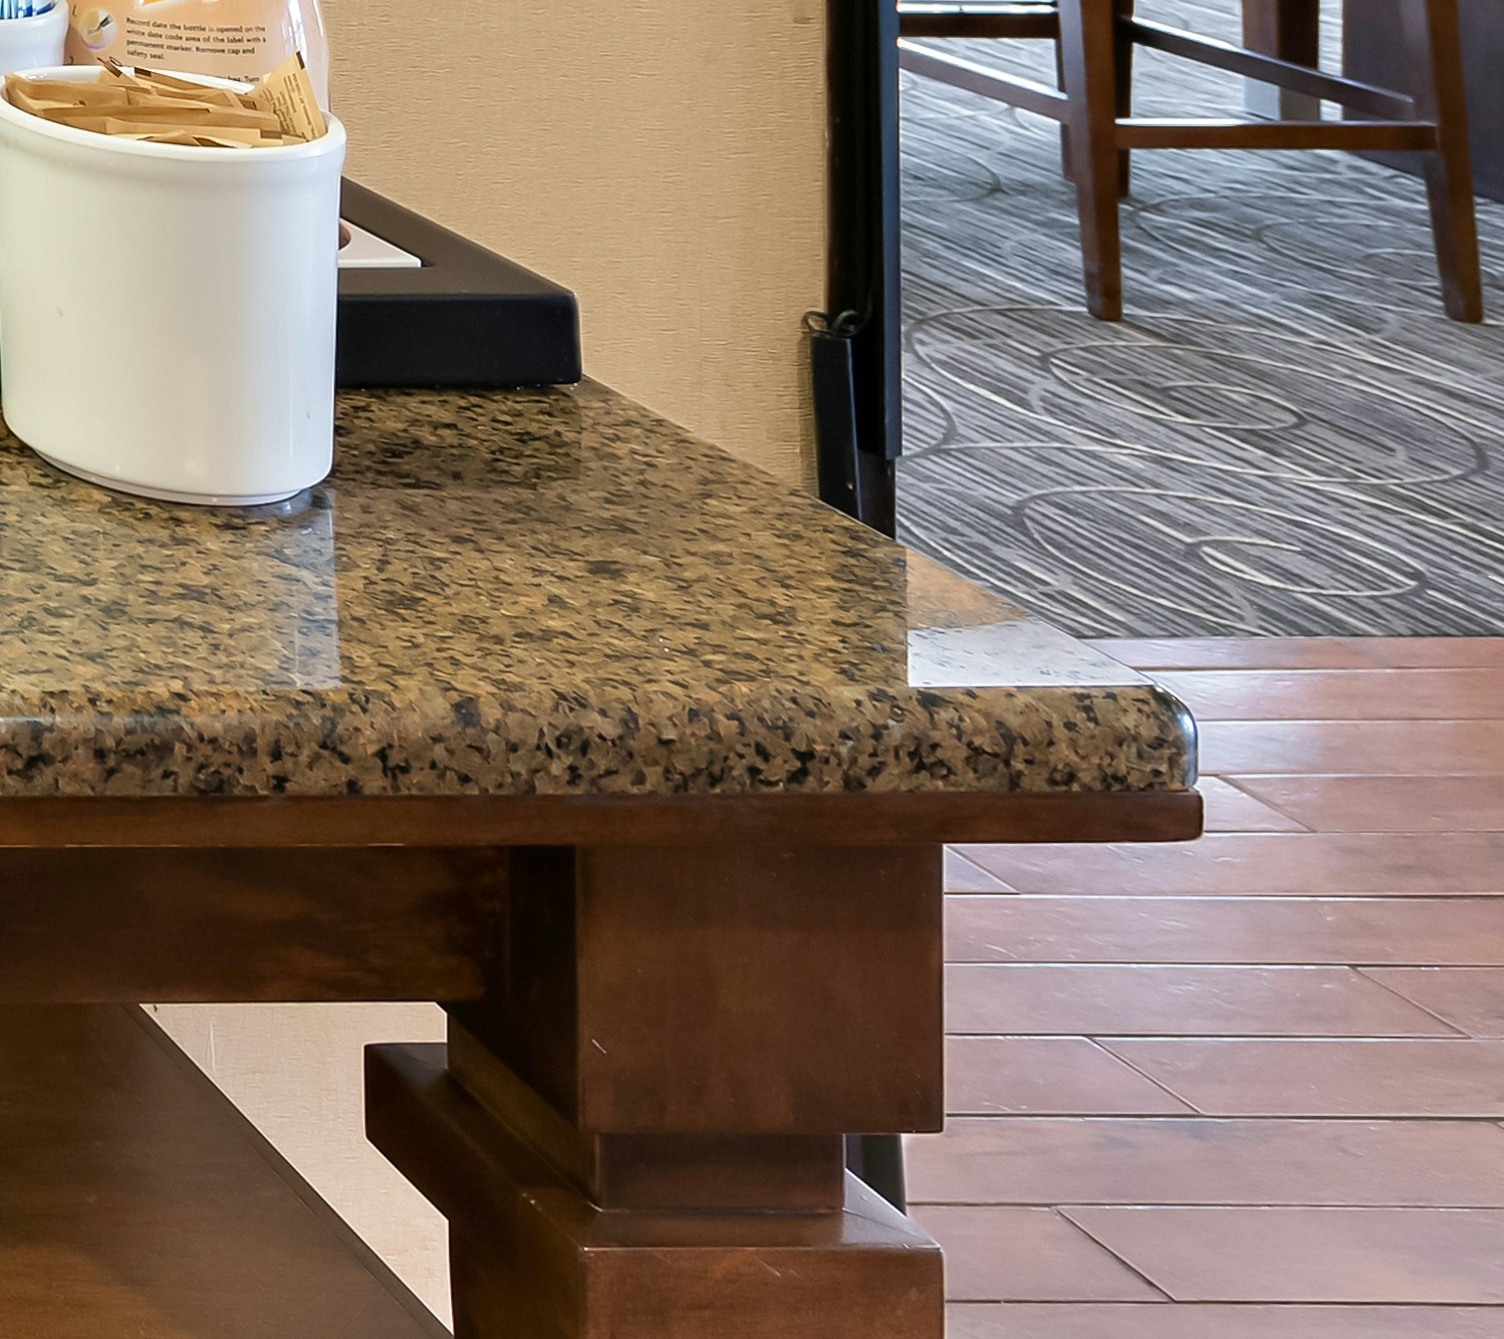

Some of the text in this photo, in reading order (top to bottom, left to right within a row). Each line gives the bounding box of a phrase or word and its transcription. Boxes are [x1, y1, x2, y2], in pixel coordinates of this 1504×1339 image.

[126, 17, 150, 27] Record
[152, 21, 167, 29] date
[169, 22, 181, 30] the
[183, 24, 206, 32] bottle
[216, 26, 242, 34] opened
[147, 31, 163, 39] date
[165, 32, 183, 41] code
[202, 35, 211, 43] of
[126, 39, 165, 50] permanent
[196, 46, 226, 54] Remove
[127, 49, 148, 59] safety
